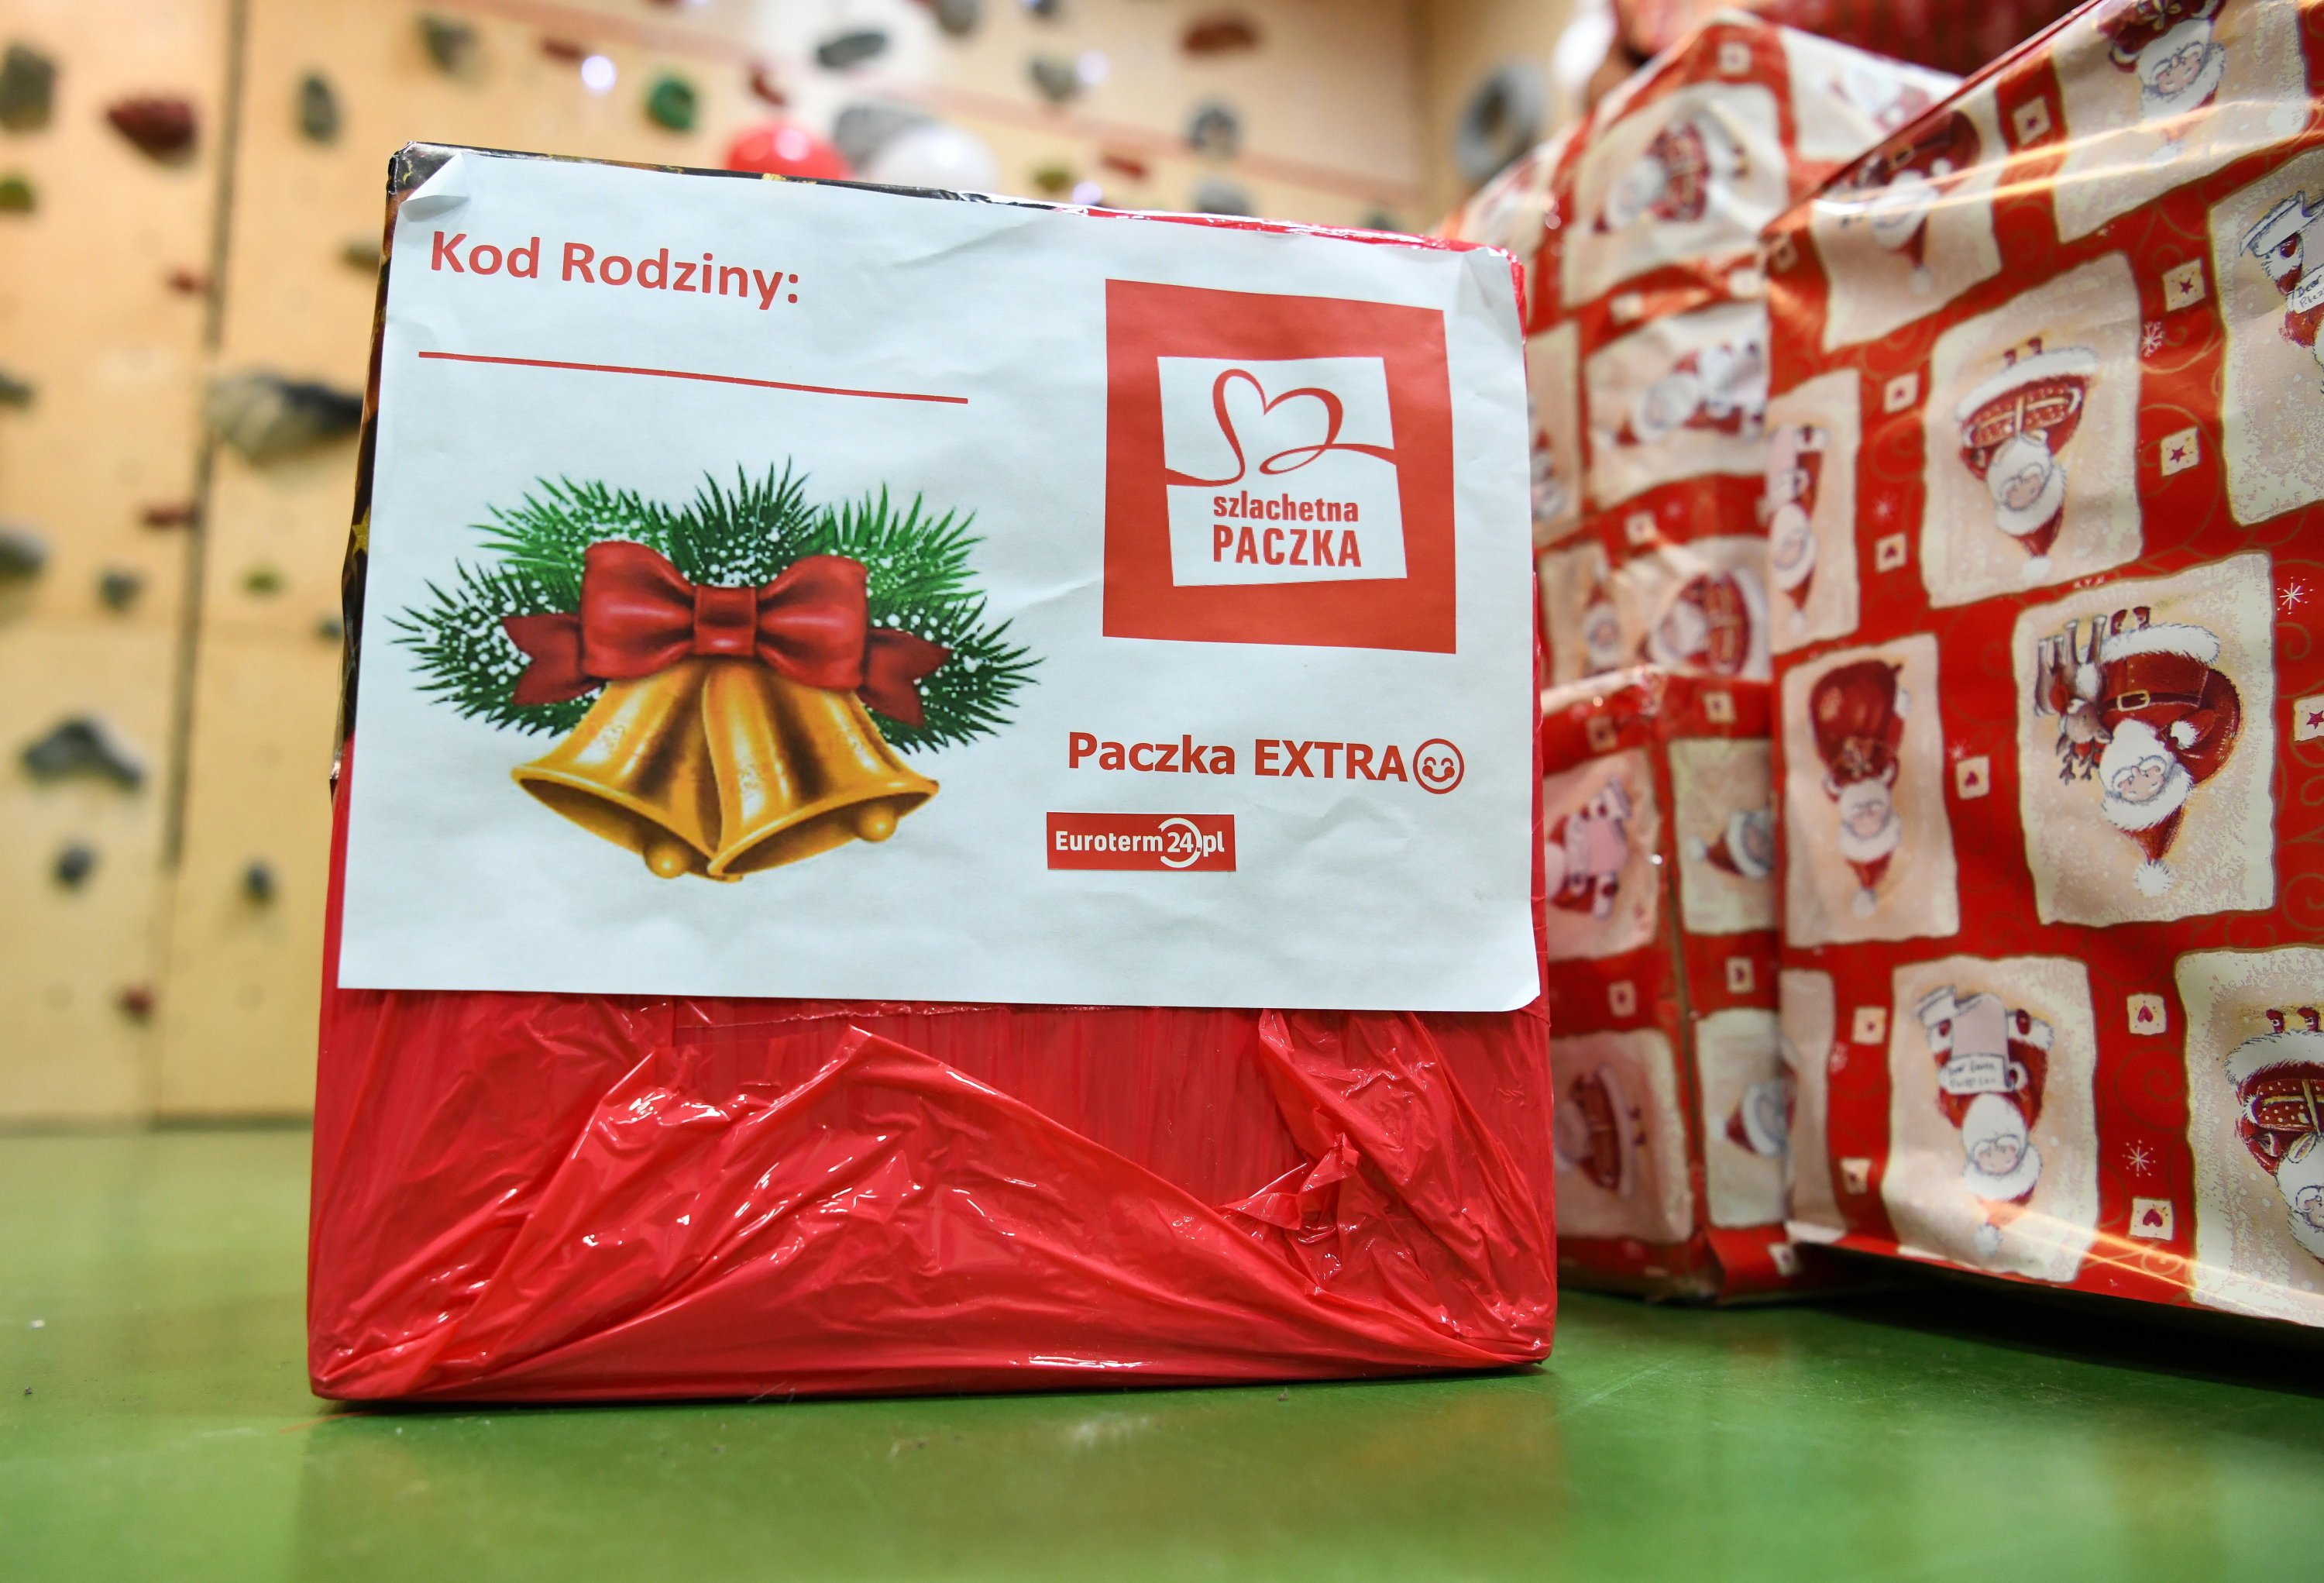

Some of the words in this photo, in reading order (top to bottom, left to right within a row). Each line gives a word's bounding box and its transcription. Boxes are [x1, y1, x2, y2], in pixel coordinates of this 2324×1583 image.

[431, 231, 540, 279] Kod
[562, 242, 799, 311] Rodziny:
[1213, 490, 1360, 523] szlachetna
[1213, 525, 1362, 567] PACZKA
[1068, 731, 1236, 775] Paczka
[1254, 738, 1408, 782] EXTRA
